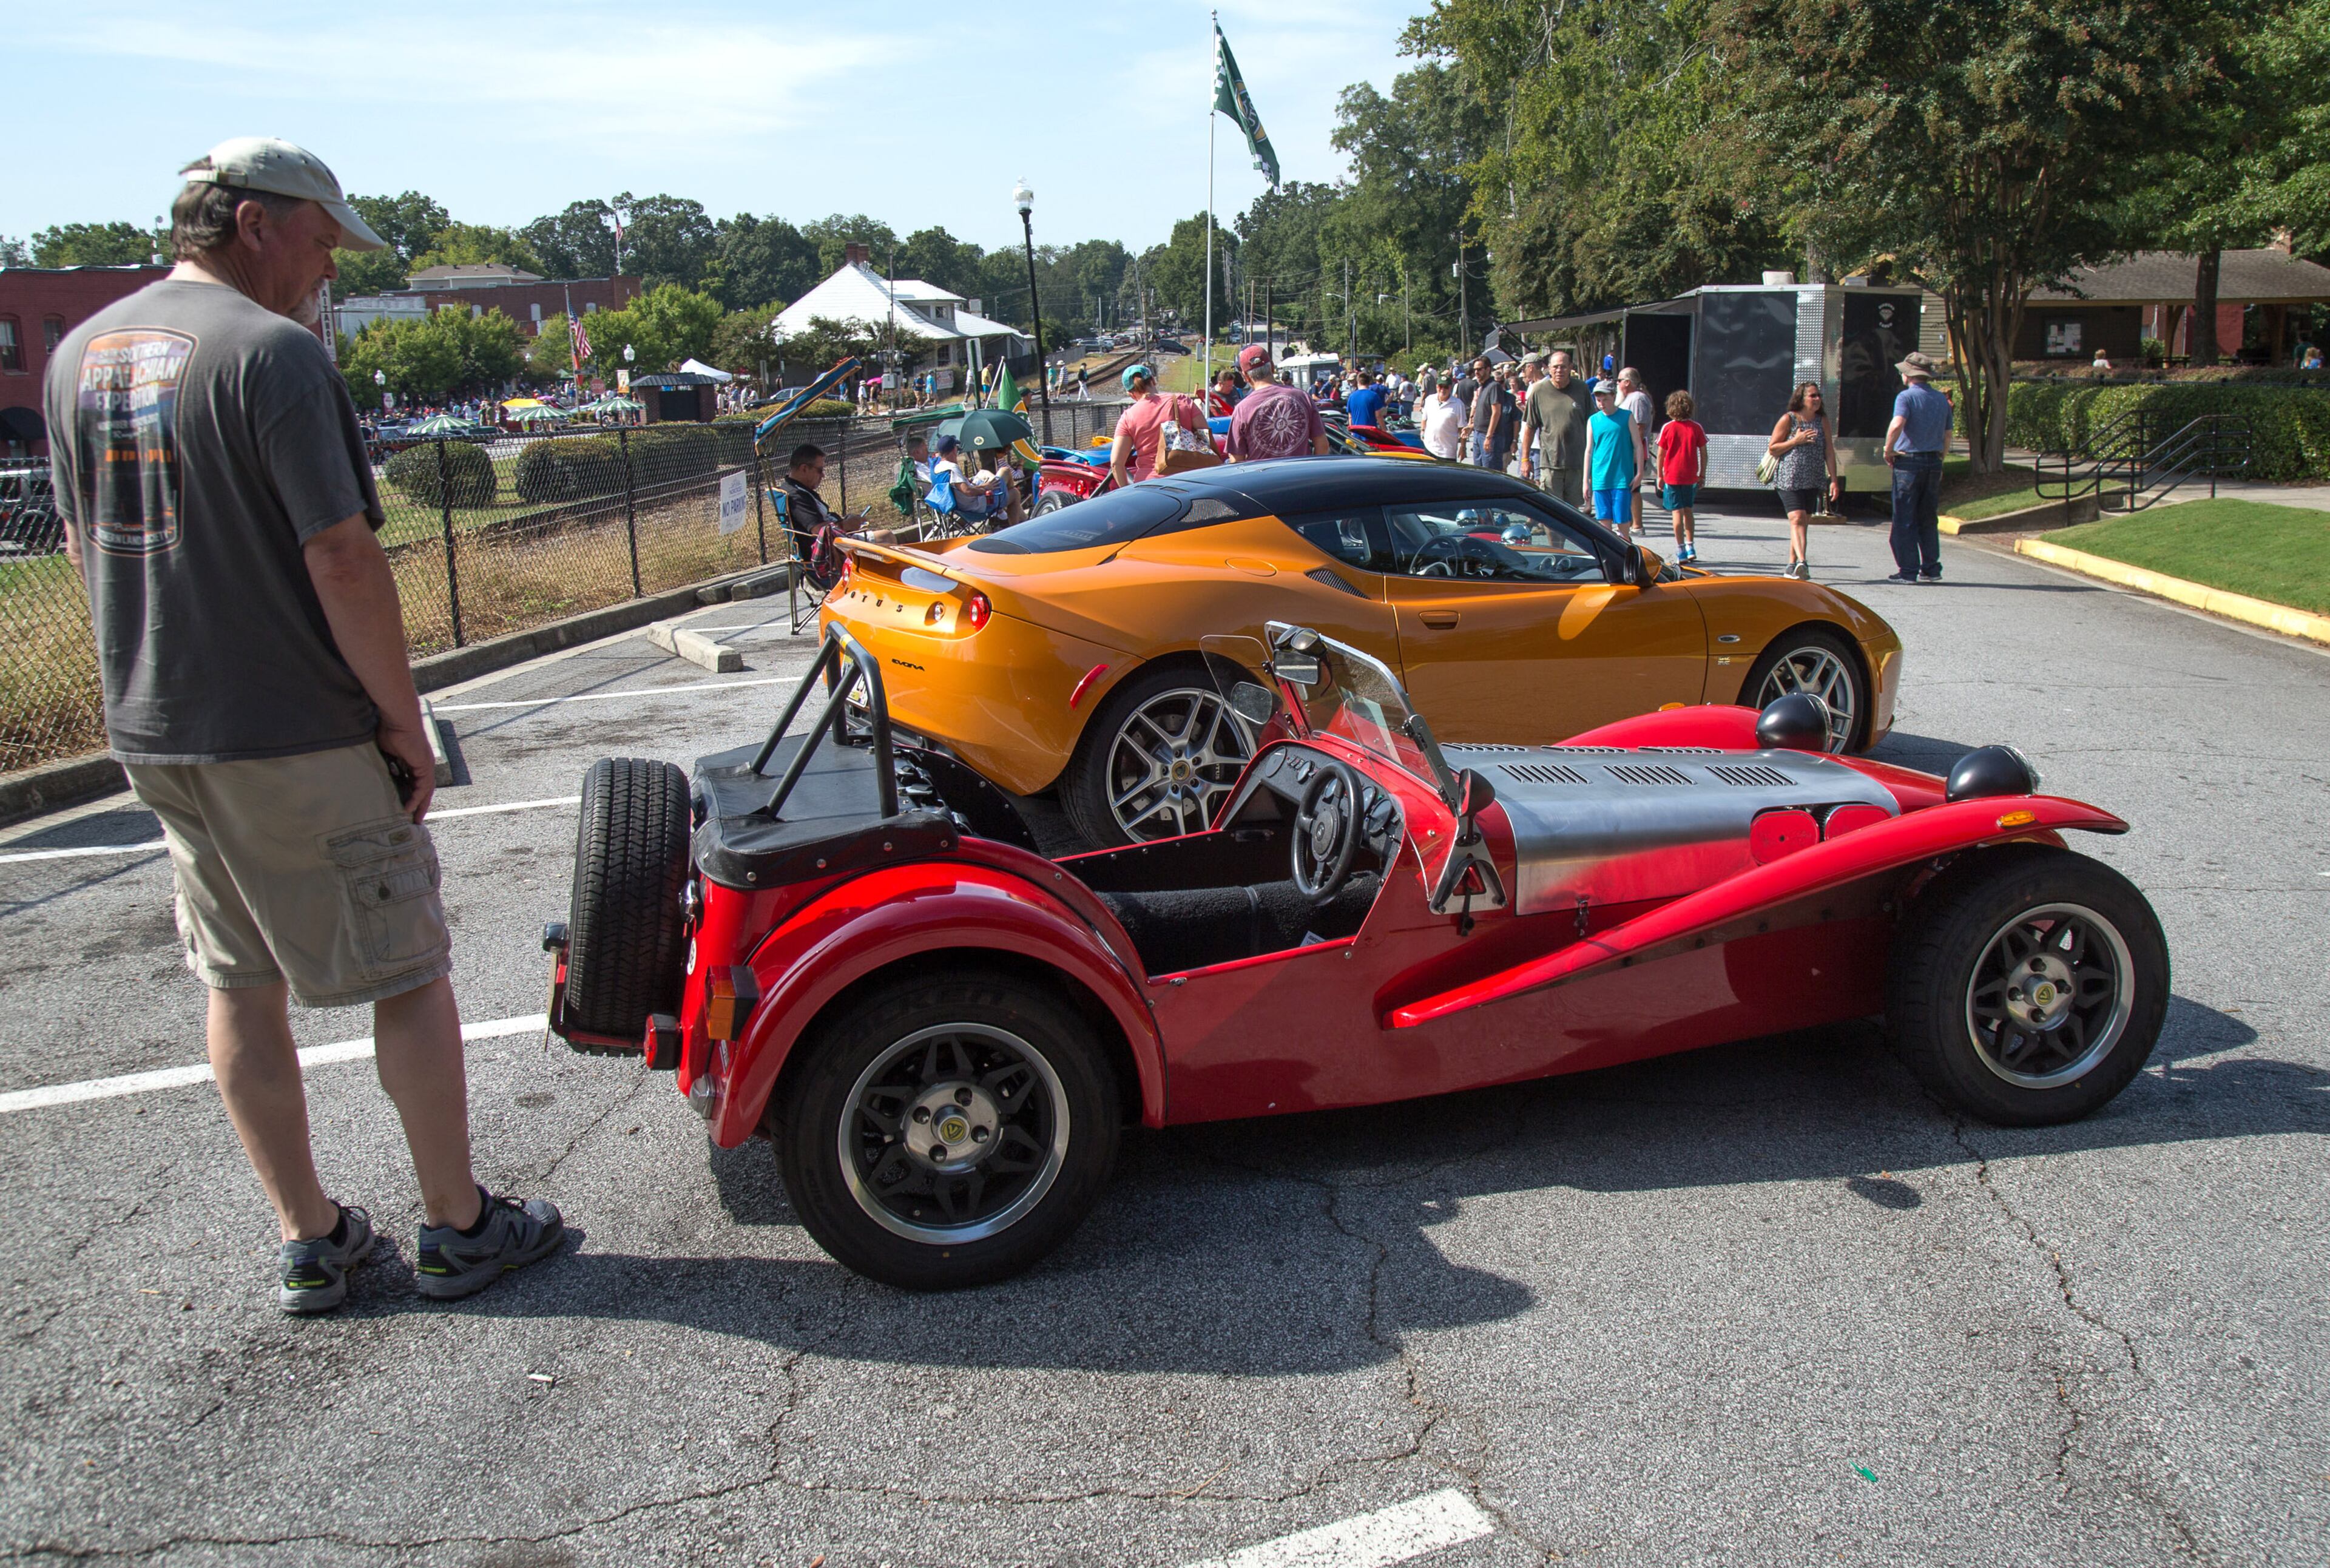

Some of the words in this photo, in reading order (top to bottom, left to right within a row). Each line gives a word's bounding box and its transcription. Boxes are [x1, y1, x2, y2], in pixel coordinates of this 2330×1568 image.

[81, 356, 182, 392] APPACHIAN
[722, 501, 731, 518] NO
[844, 587, 903, 613] LOTUS
[891, 658, 925, 672] EVORA
